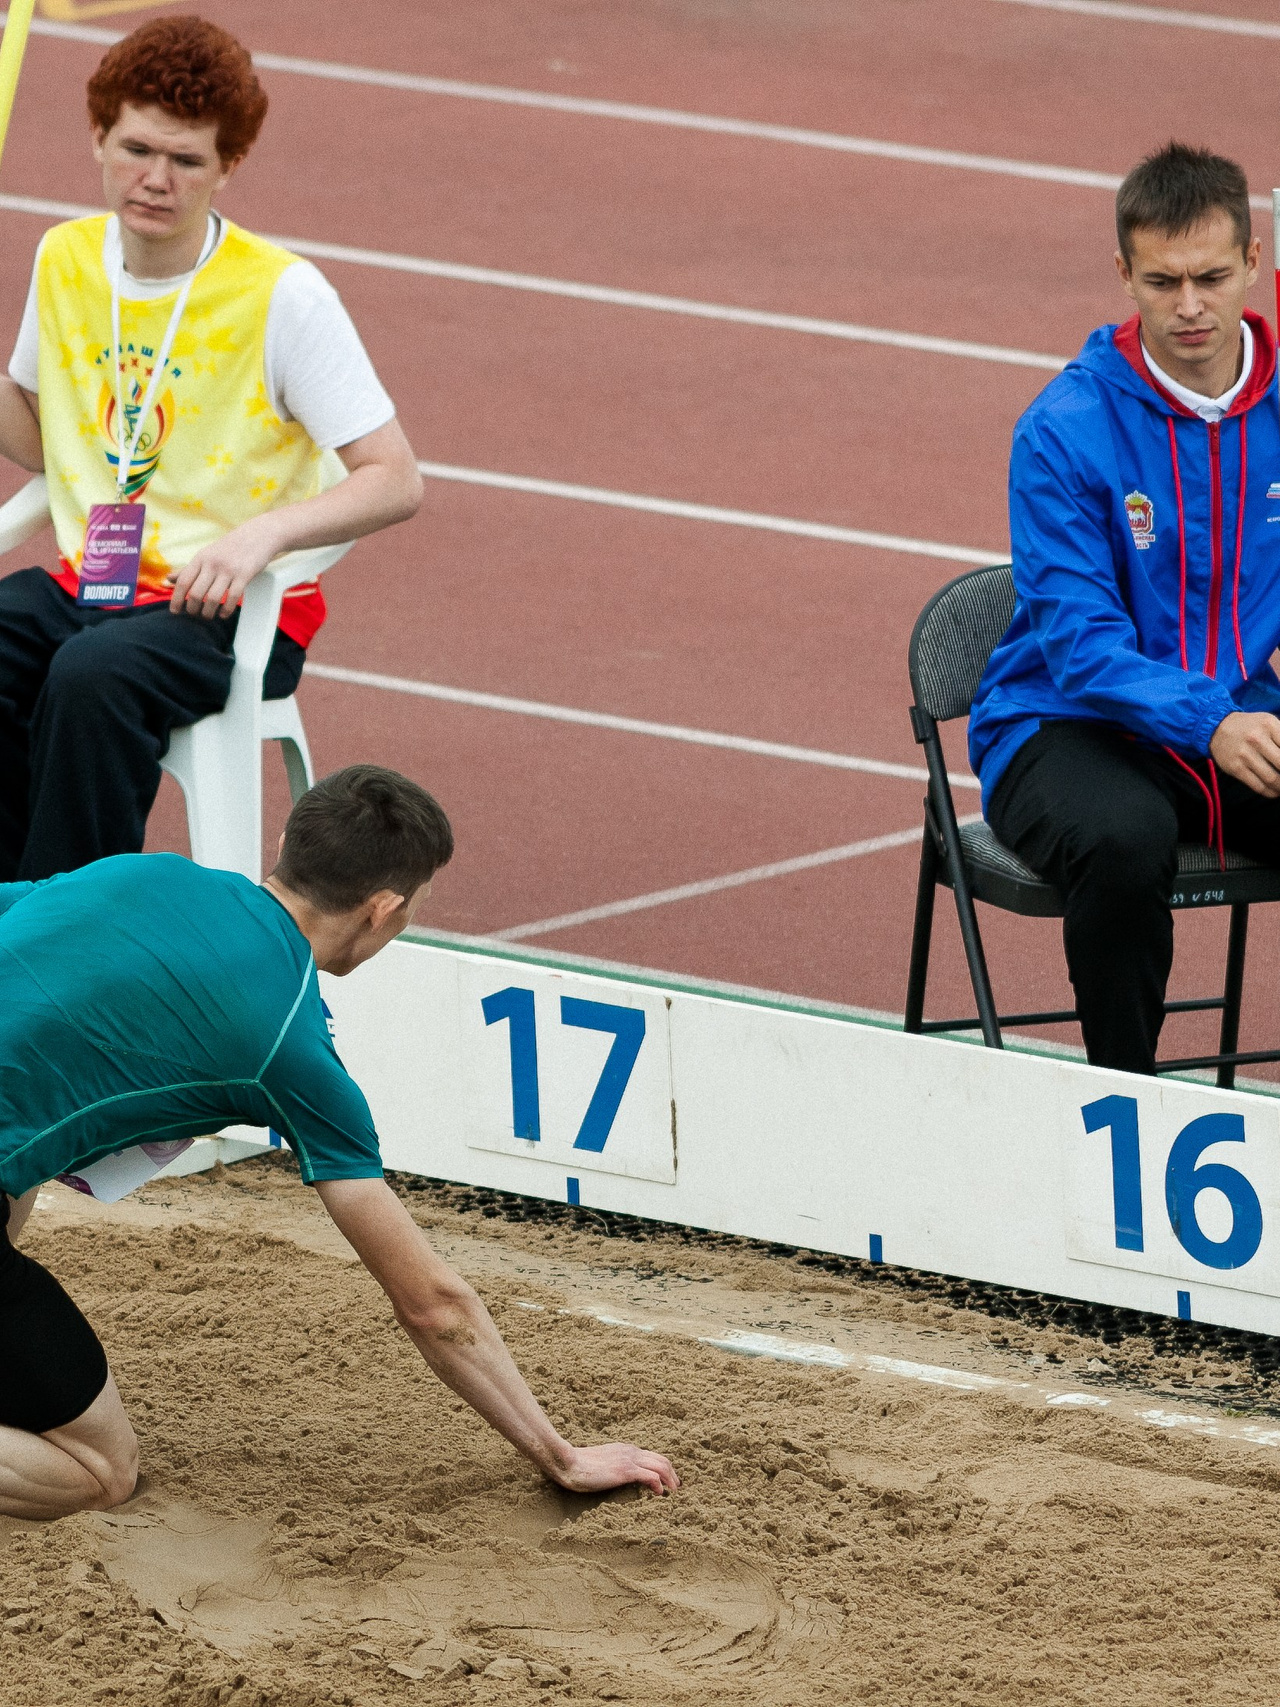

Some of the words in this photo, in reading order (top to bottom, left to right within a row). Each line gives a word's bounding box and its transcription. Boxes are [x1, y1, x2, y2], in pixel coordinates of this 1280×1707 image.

[83, 585, 130, 600] ВОЛОНТЕР
[481, 986, 646, 1154] 17
[1080, 1094, 1263, 1270] 16
